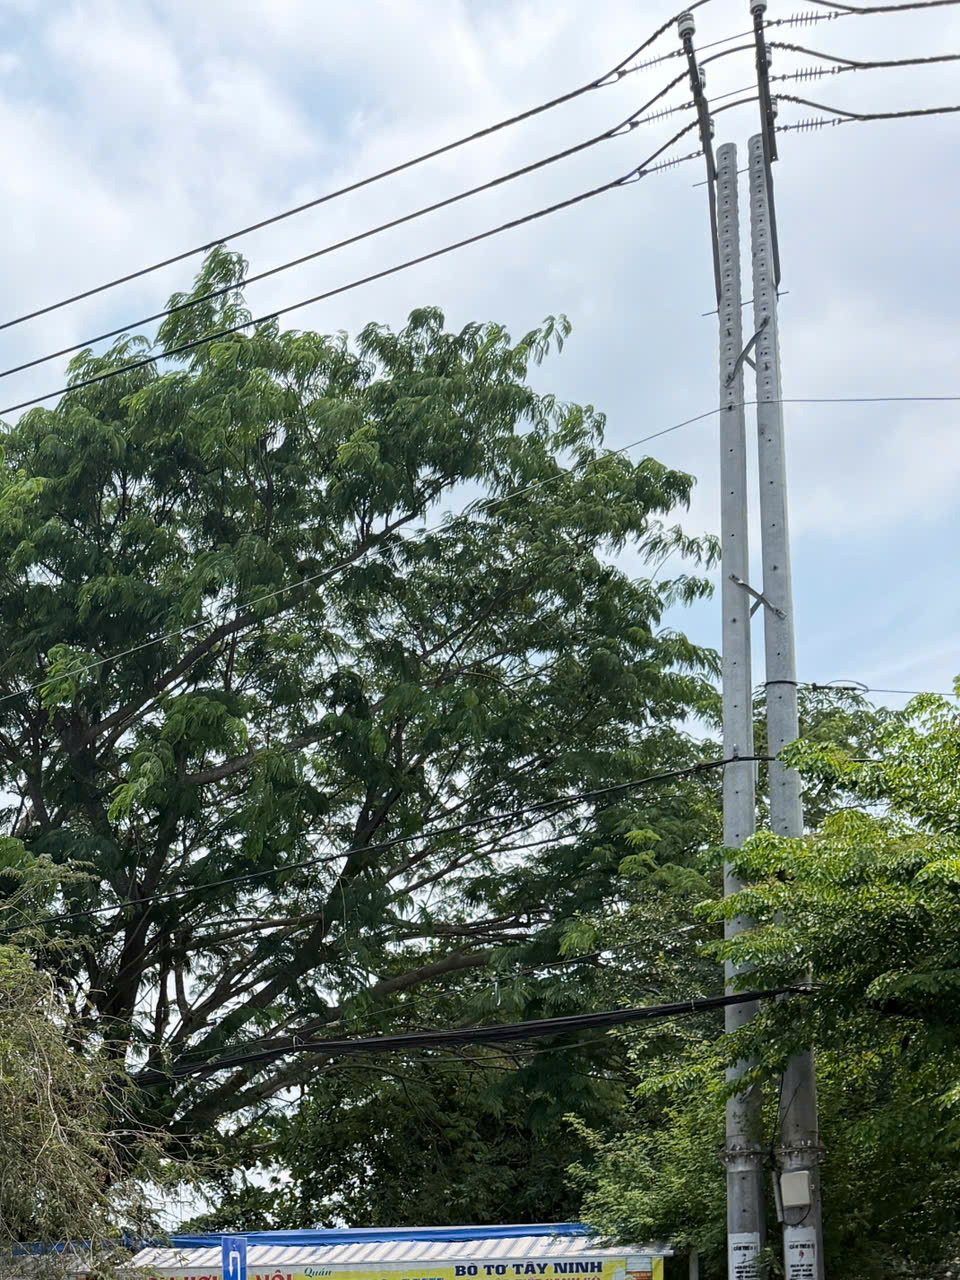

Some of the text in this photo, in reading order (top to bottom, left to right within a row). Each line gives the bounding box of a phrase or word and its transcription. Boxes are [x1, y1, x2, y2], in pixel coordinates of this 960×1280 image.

[455, 1260, 603, 1276] BÒ TƠ TÂY NINH
